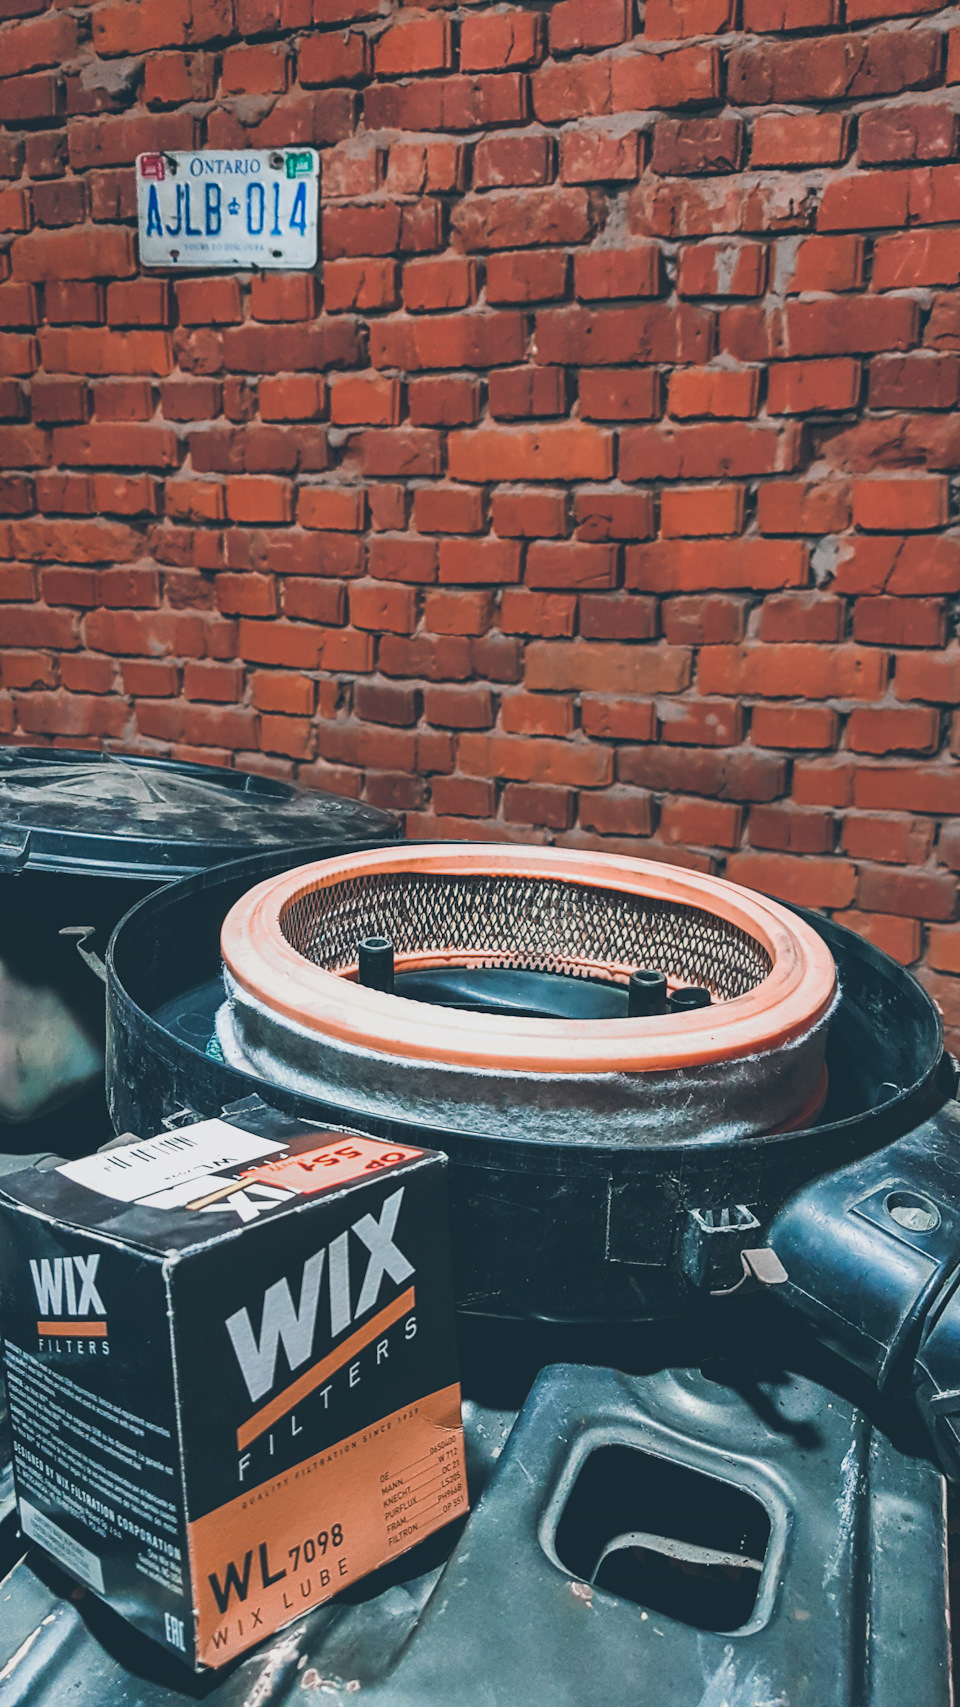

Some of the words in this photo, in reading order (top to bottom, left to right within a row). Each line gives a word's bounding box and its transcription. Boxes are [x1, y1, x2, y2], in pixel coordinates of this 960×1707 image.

[190, 158, 261, 177] ONTARIO
[146, 182, 222, 237] AJLB
[246, 181, 307, 237] 014
[297, 1146, 362, 1172] 551
[29, 1253, 107, 1316] WIX
[225, 1187, 417, 1403] WIX
[38, 1338, 110, 1356] FILTERS
[239, 1316, 418, 1482] FILTERS
[241, 1478, 289, 1510] QUALITY
[294, 1441, 358, 1480] FILTRATION
[362, 1422, 393, 1443] SINCE
[381, 1477, 404, 1495] MANN
[383, 1487, 411, 1507] KNECHT
[384, 1497, 418, 1519] PURFLUX
[70, 1481, 116, 1523] FILTRATION
[117, 1514, 182, 1561] CORPORATION
[386, 1517, 407, 1532] FRAM
[388, 1524, 418, 1546] FILTRON
[207, 1542, 288, 1614] WL
[288, 1523, 345, 1572] 7098
[210, 1607, 264, 1650] WIX
[283, 1557, 350, 1609] LUBE
